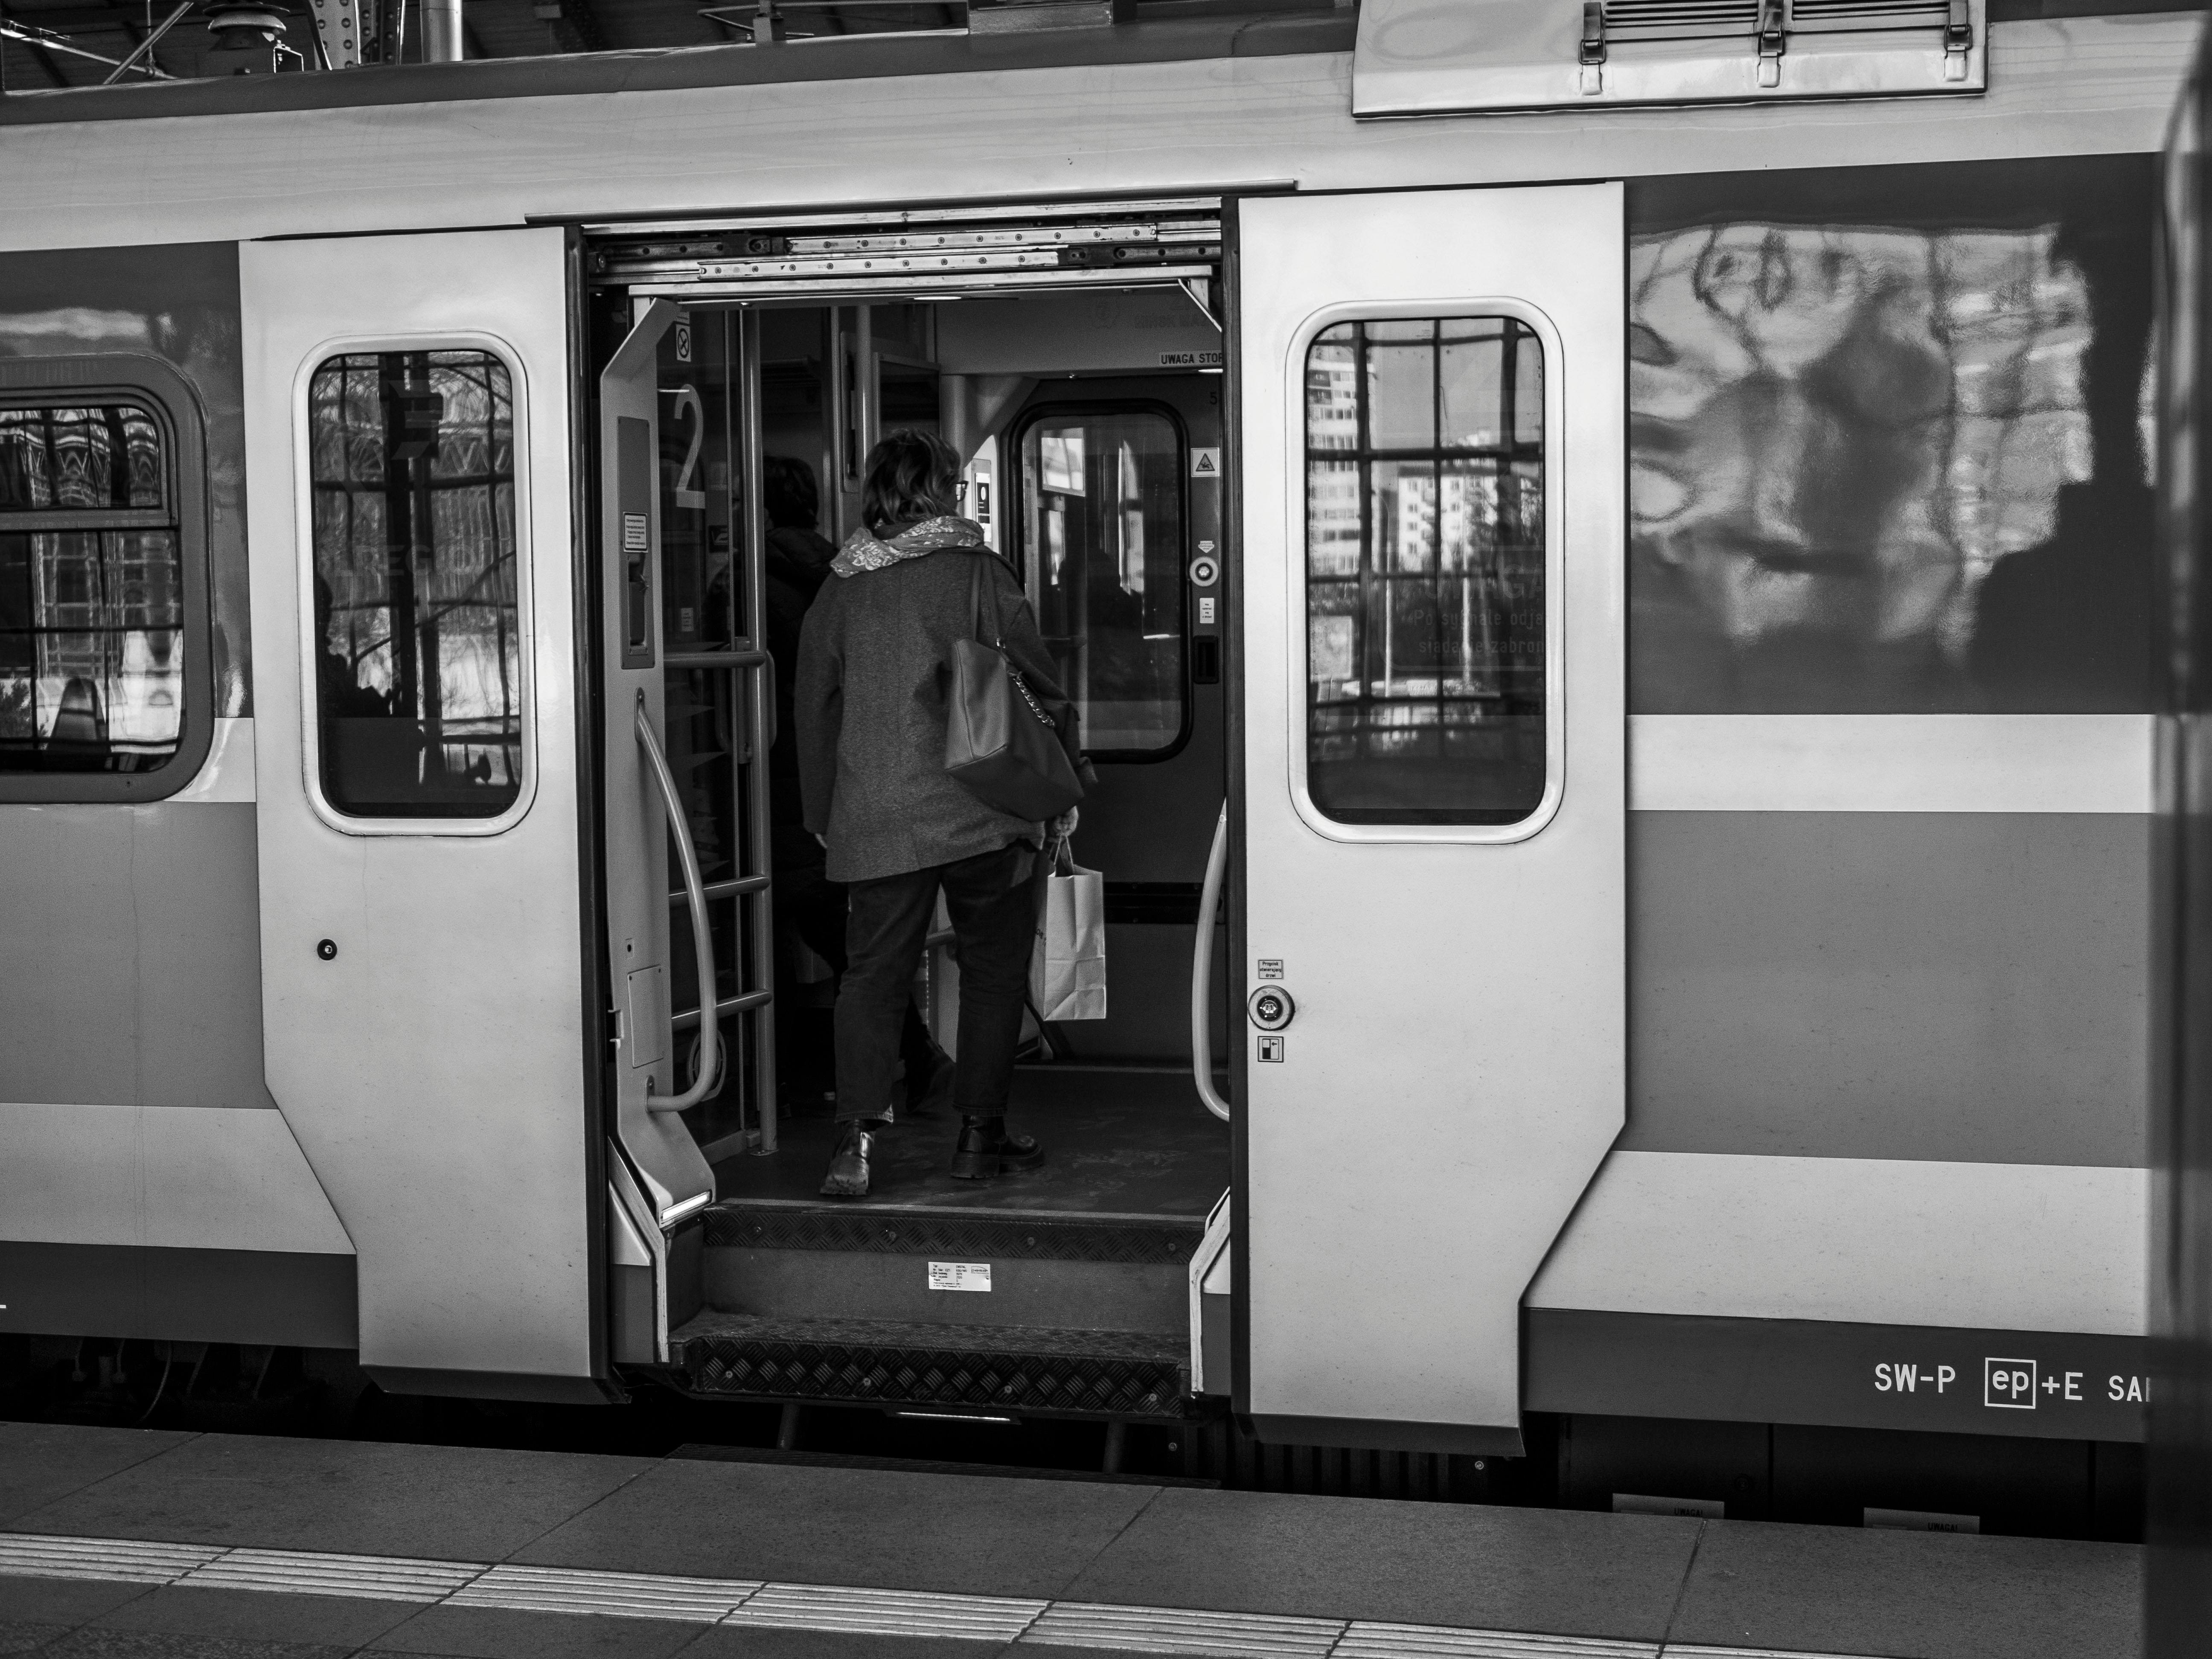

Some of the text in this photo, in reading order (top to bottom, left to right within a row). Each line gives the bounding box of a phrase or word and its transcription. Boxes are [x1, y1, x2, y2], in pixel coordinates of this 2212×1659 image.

[1161, 354, 1194, 364] UWAGA
[674, 384, 705, 509] 2
[1874, 1363, 1956, 1394] SW-P
[1674, 1508, 1703, 1517] UWAGA!
[1928, 1522, 1958, 1532] UWAGA!
